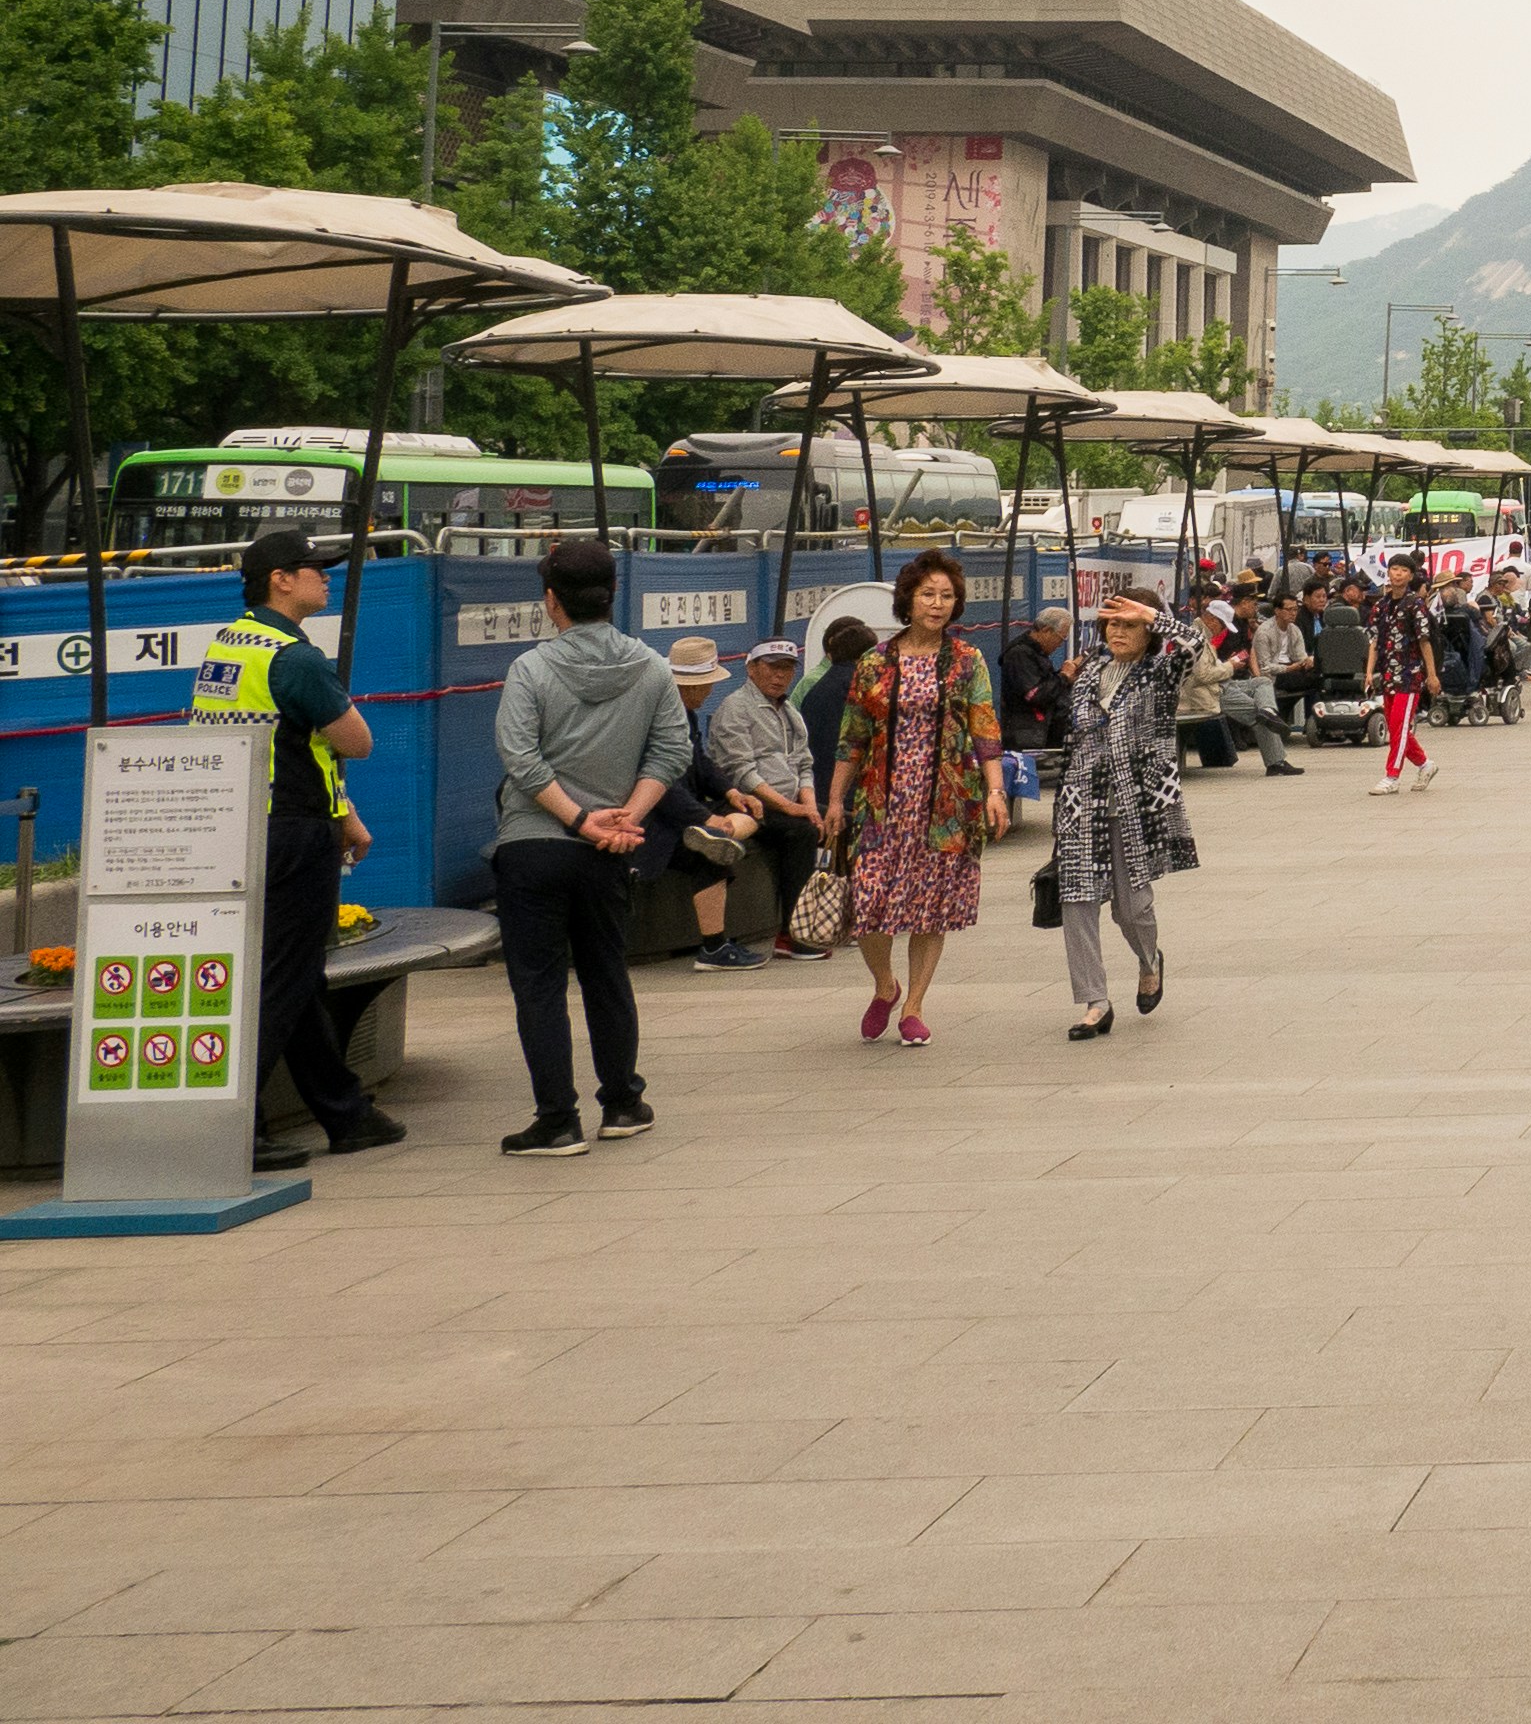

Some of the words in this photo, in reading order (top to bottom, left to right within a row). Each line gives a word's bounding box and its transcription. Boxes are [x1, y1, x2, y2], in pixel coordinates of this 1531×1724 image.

[192, 506, 223, 517] 위하여
[135, 632, 178, 666] 제
[202, 663, 237, 683] 경찰
[197, 683, 232, 696] POLICE
[118, 756, 175, 773] 분수시설
[180, 754, 224, 772] 안내문
[134, 920, 198, 938] 이용안내
